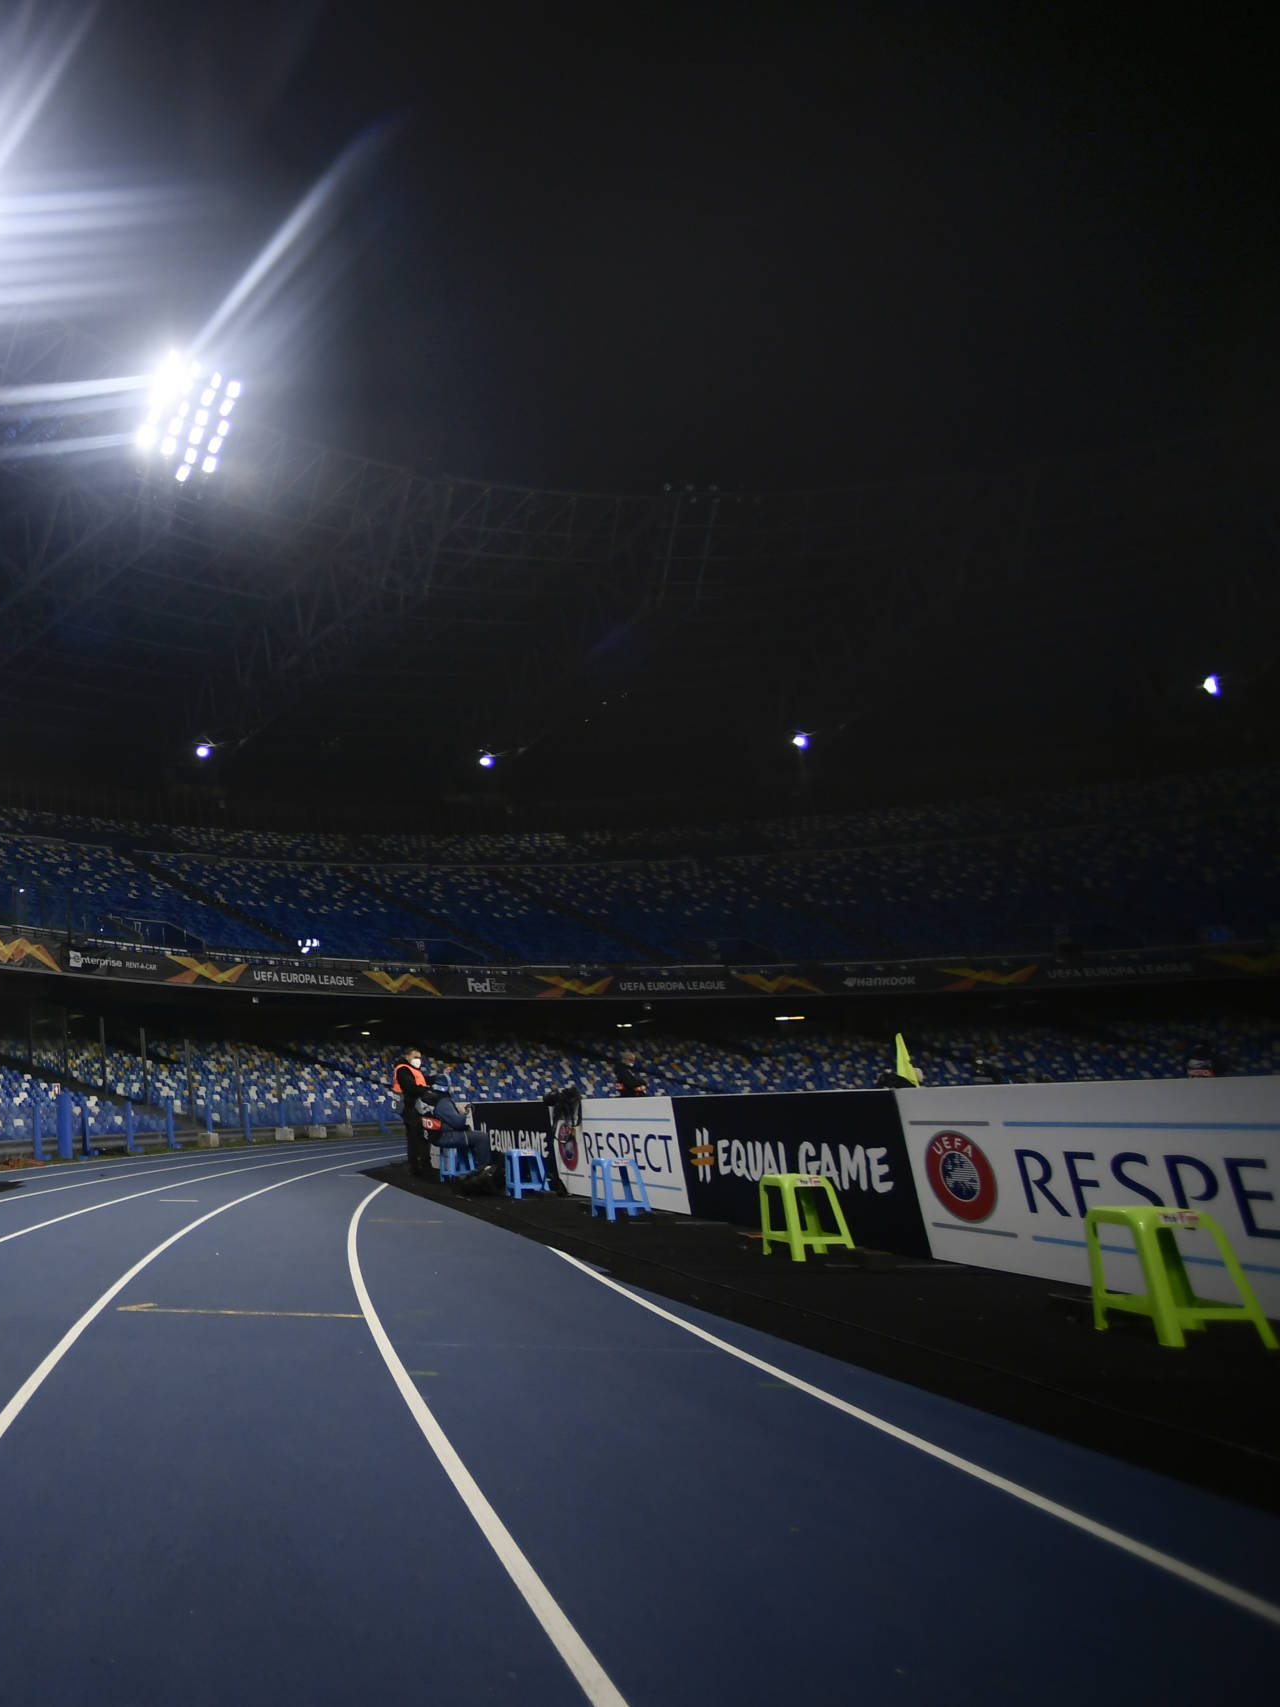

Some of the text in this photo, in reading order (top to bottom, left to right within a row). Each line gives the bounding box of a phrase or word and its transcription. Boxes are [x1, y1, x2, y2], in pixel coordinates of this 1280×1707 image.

[253, 970, 355, 986] UEFA EUROPA LEAGUE
[1047, 962, 1193, 979] UEFA EUROPA LEAGUE
[466, 977, 507, 993] FedEx
[620, 980, 727, 992] UEFA EUROPA LEAGUE
[583, 1131, 673, 1174] RESPECT
[932, 1134, 974, 1158] UEFA
